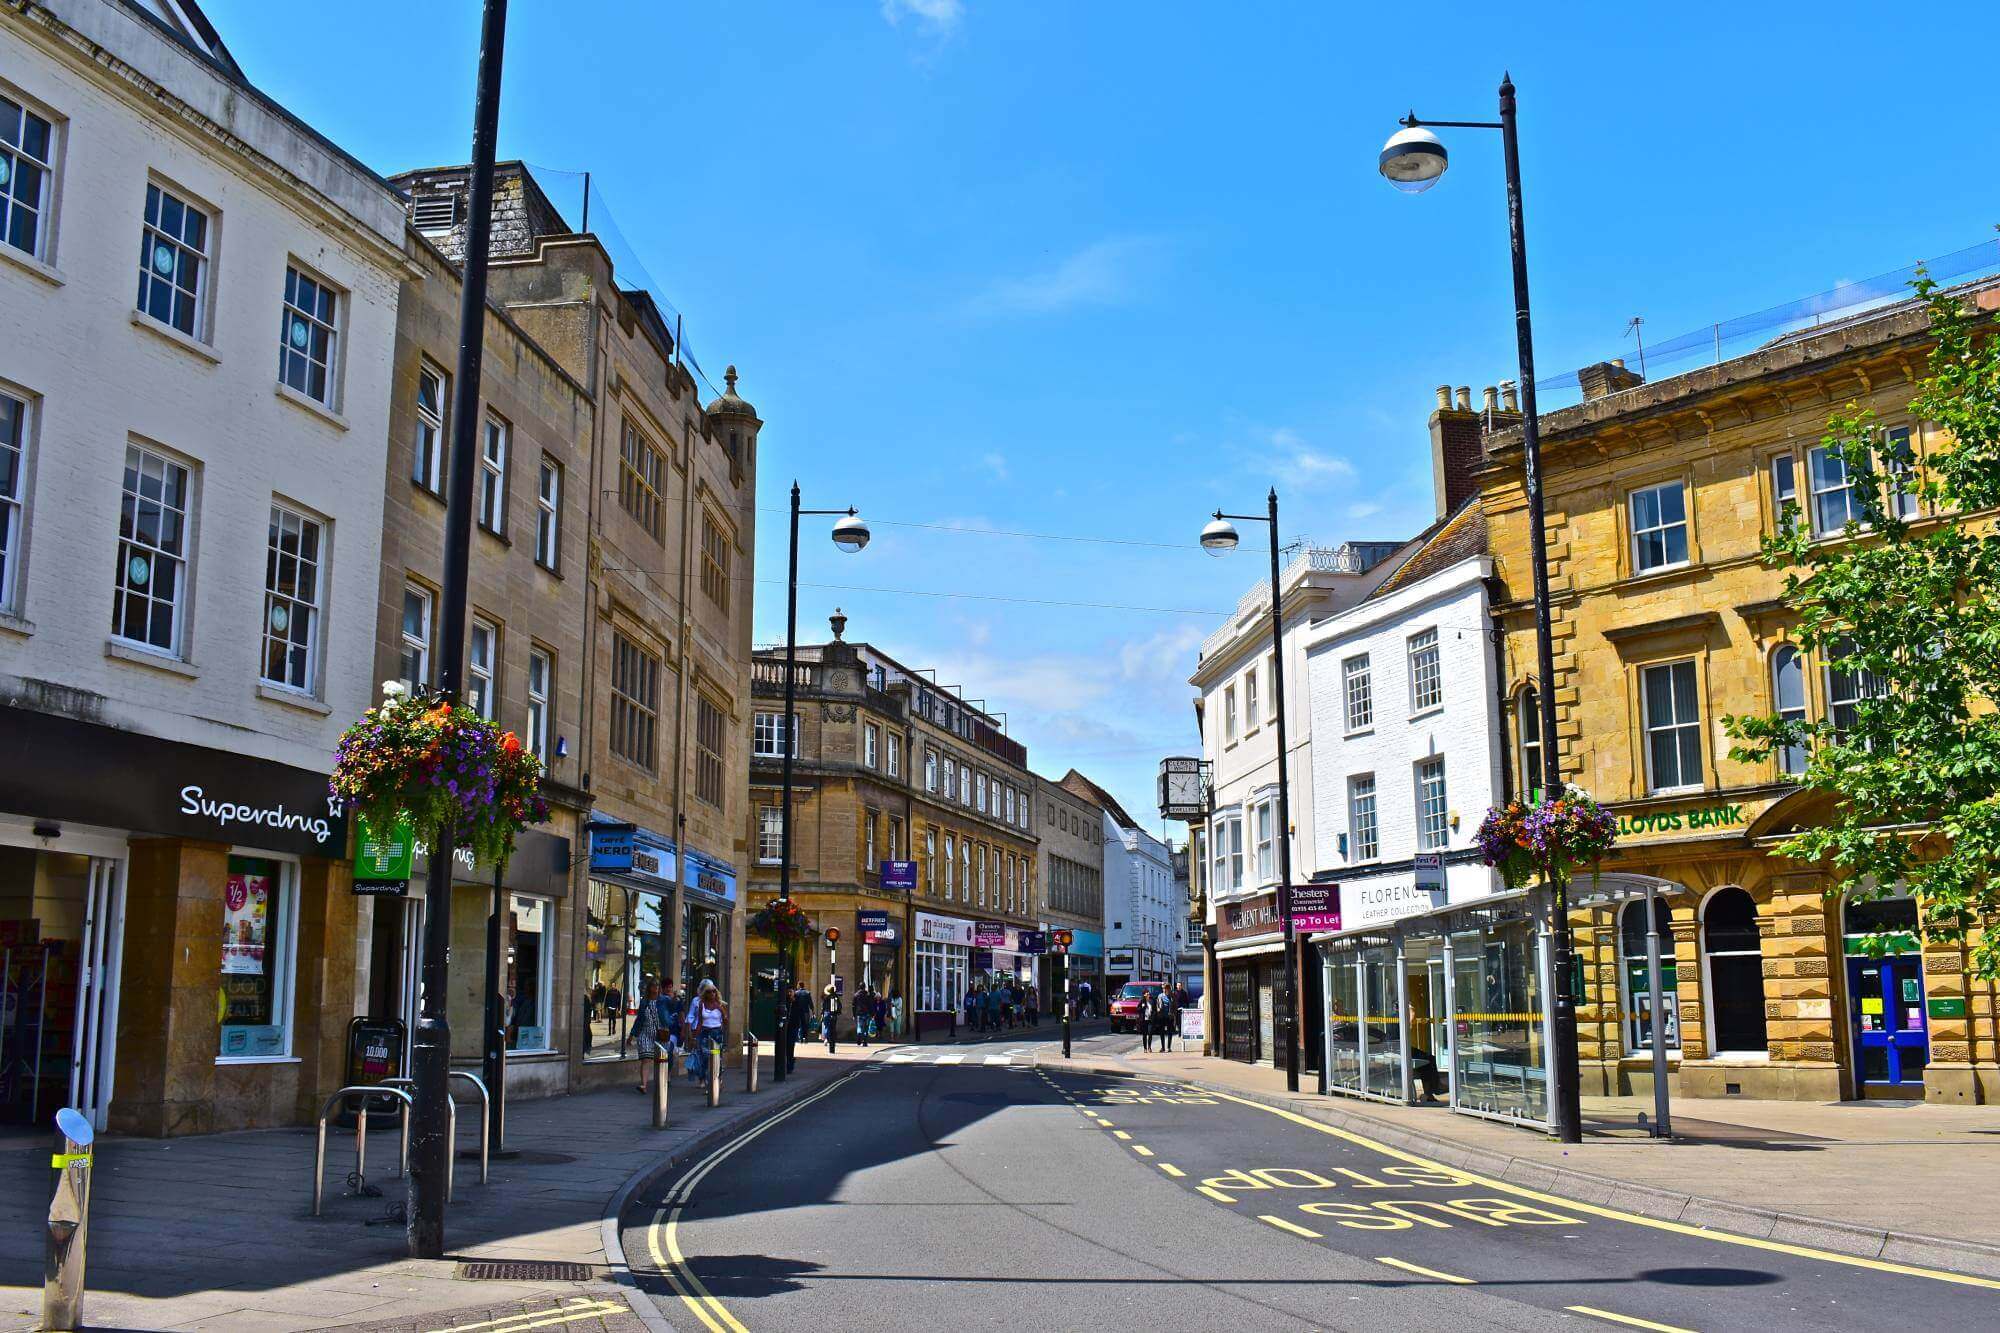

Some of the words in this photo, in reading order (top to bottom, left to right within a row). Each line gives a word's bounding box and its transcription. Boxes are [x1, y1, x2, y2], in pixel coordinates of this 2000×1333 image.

[180, 785, 331, 843] Superdrug
[1687, 805, 1744, 829] BANK
[593, 846, 631, 855] NERO
[354, 883, 401, 893] Superdrug
[1232, 908, 1258, 930] CLEMENT
[1308, 916, 1321, 924] To
[1323, 915, 1339, 924] Let
[1362, 908, 1388, 919] LEATHER
[366, 1045, 388, 1059] 10,000
[1200, 1167, 1473, 1190] STOP
[1298, 1198, 1588, 1230] BUS
